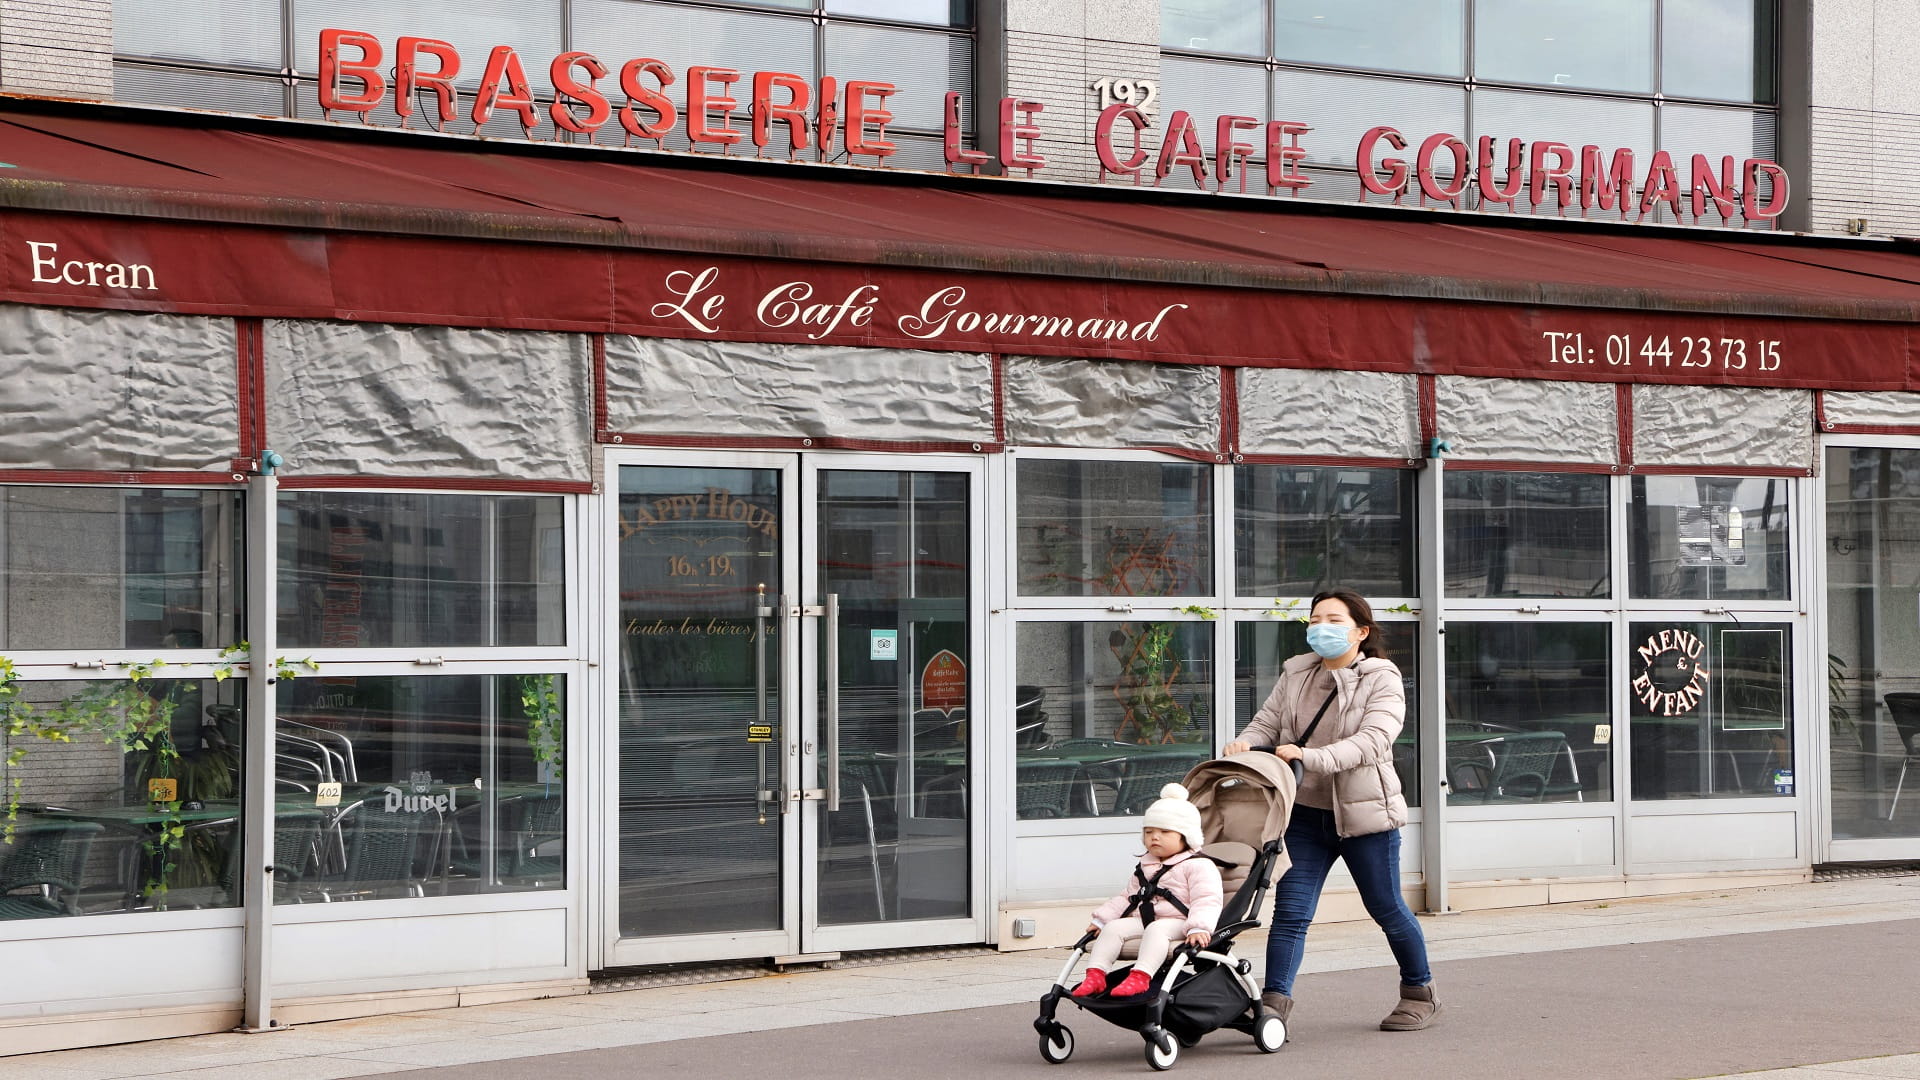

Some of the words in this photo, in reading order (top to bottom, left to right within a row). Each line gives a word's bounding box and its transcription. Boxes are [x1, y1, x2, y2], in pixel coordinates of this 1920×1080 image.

[1093, 77, 1157, 115] 192
[318, 28, 902, 157] BRASSERIE
[944, 90, 1048, 169] LE
[1096, 104, 1314, 189] CAFE
[1355, 126, 1790, 221] GOURMAND
[26, 240, 159, 291] Ecran
[650, 266, 726, 333] Le
[756, 280, 879, 340] Café
[898, 285, 1189, 343] Gourmand
[1542, 331, 1595, 365] Tél:
[1605, 334, 1631, 367] 01
[1640, 335, 1673, 367] 44
[1680, 336, 1713, 369] 23
[1720, 337, 1748, 371] 73
[1758, 339, 1782, 372] 15
[625, 617, 675, 636] toutes
[679, 616, 701, 636] les
[1637, 629, 1705, 667] MENU
[1633, 662, 1710, 717] ENFANT
[318, 788, 340, 798] 402
[383, 785, 458, 813] Duvel
